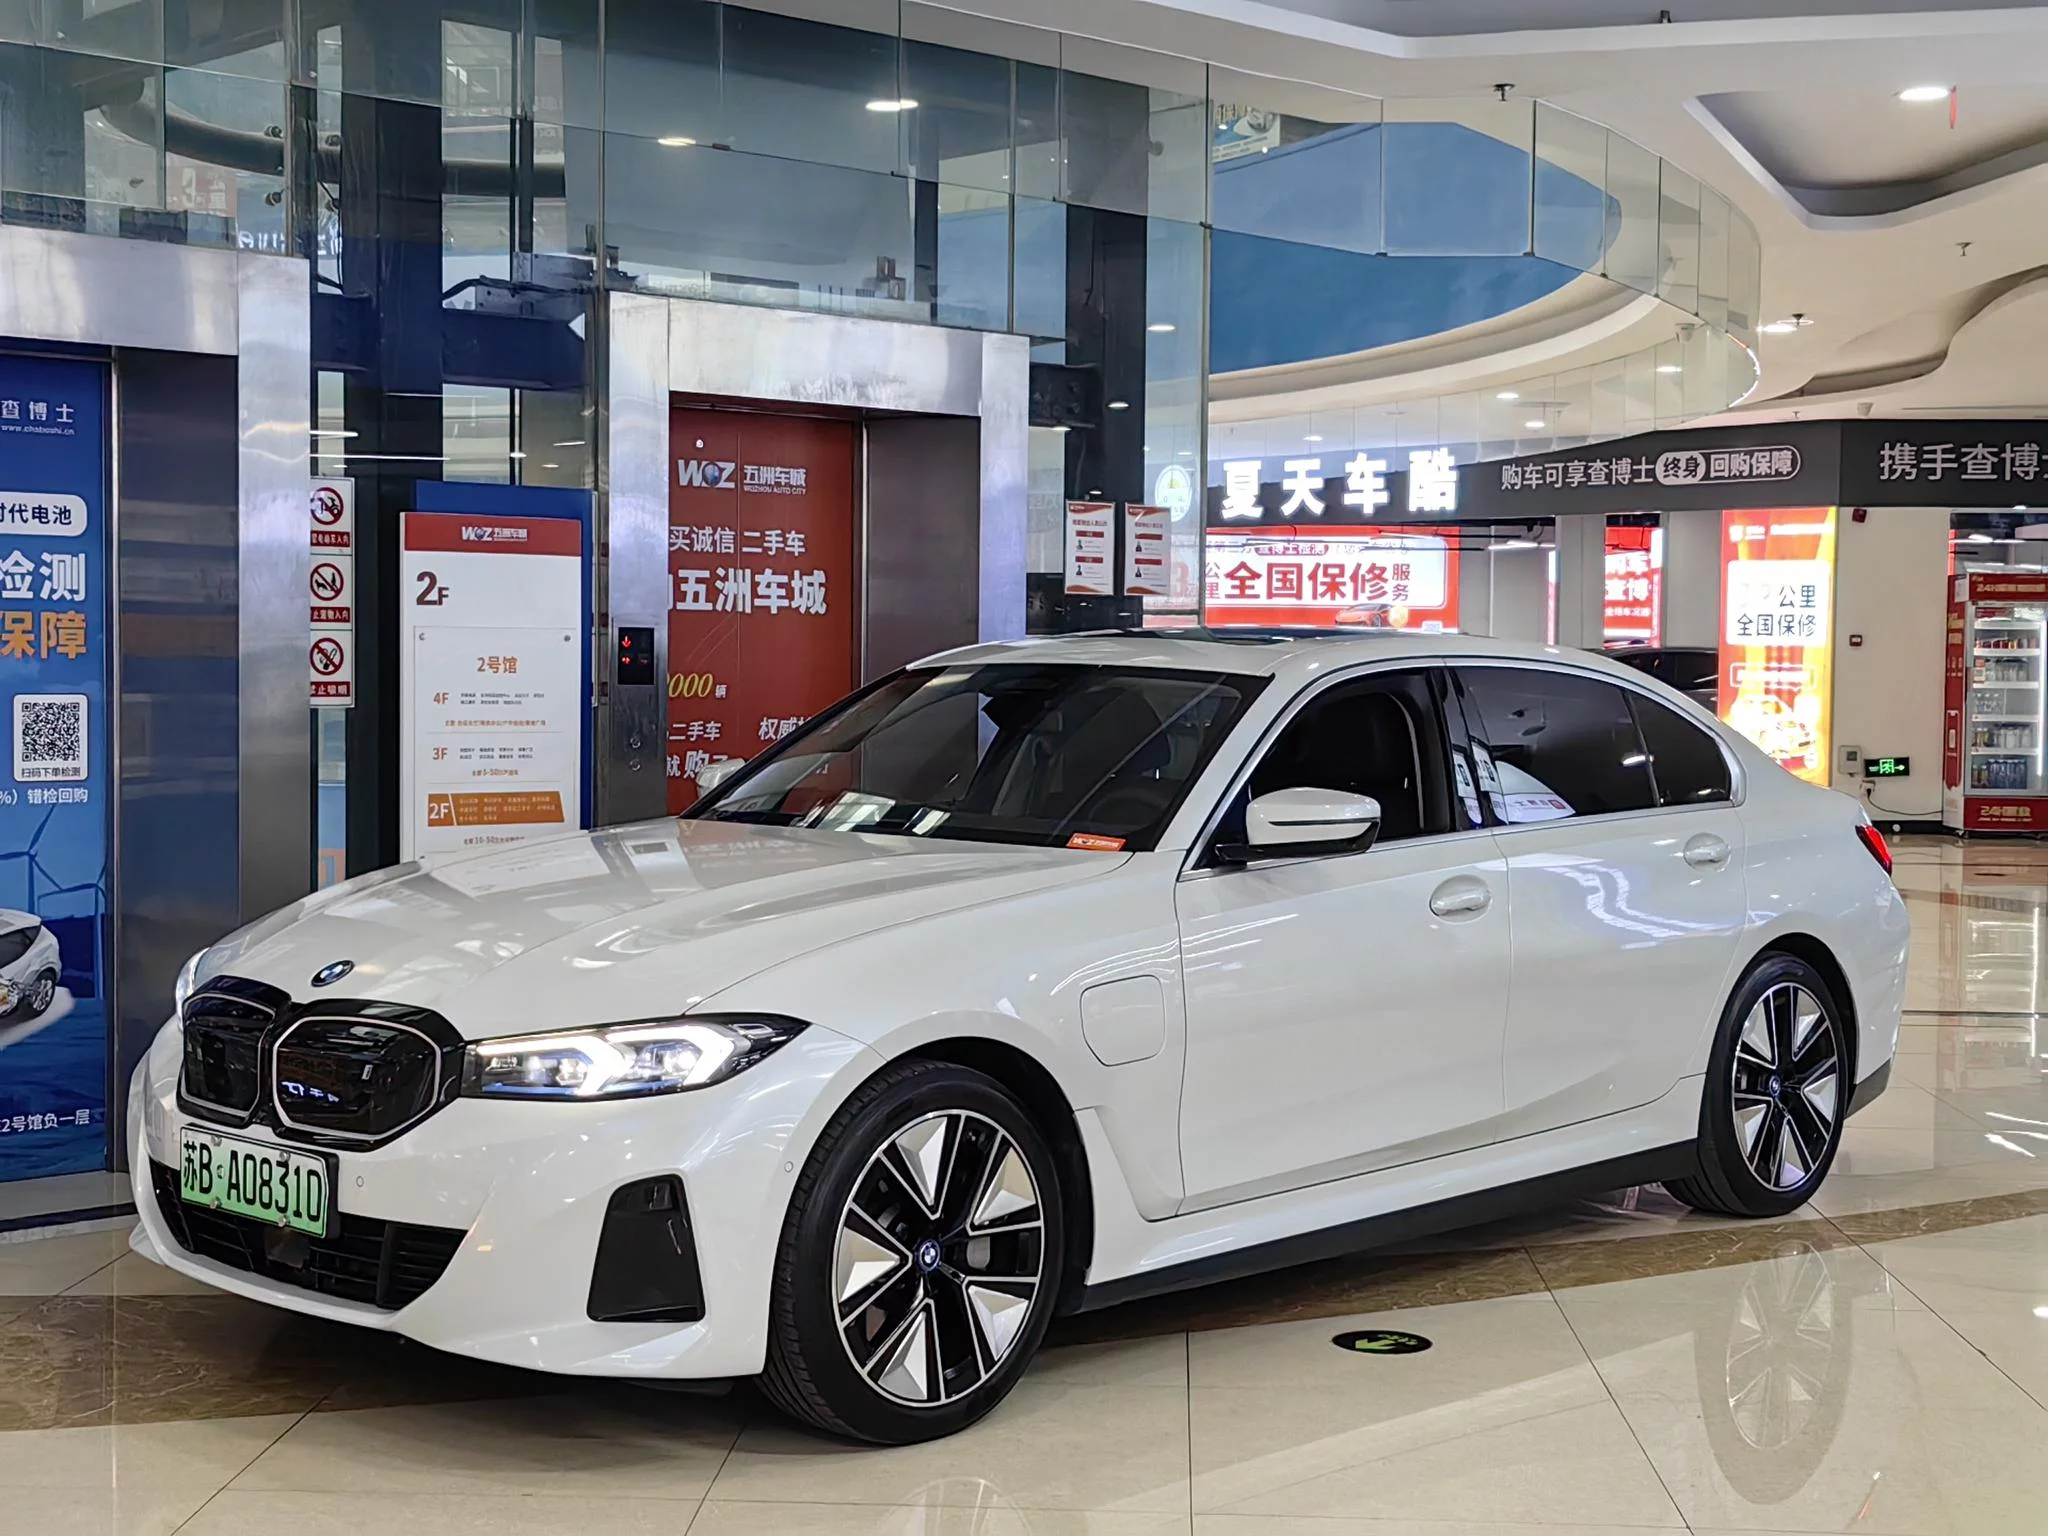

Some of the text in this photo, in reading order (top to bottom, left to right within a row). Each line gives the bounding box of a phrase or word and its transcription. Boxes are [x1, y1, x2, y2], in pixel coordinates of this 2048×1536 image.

[1, 400, 75, 423] 查博士
[1501, 449, 1793, 491] 购车可享查博士 终身 回购保障
[1879, 442, 2048, 481] 携手查博
[743, 465, 807, 487] 五洲车城
[1221, 447, 1459, 520] 夏天车酷
[0, 550, 86, 601] 检测
[1205, 560, 1411, 602] 公里 全国保修 服务
[416, 571, 449, 606] 2F
[668, 567, 828, 615] 五洲车城
[1779, 585, 1816, 608] 公里
[0, 611, 87, 660] 保障
[1737, 613, 1817, 638] 全国保修
[477, 656, 518, 674] 2号馆
[667, 673, 714, 698] 000
[433, 692, 449, 704] 4F
[667, 721, 722, 742] 二手车
[759, 717, 811, 741] 权威
[433, 747, 448, 760] 3F
[21, 767, 81, 778] 扫码下单检测
[27, 788, 89, 804] 错检回购
[429, 803, 449, 820] 2F
[0, 1108, 90, 1132] 2号馆负一层
